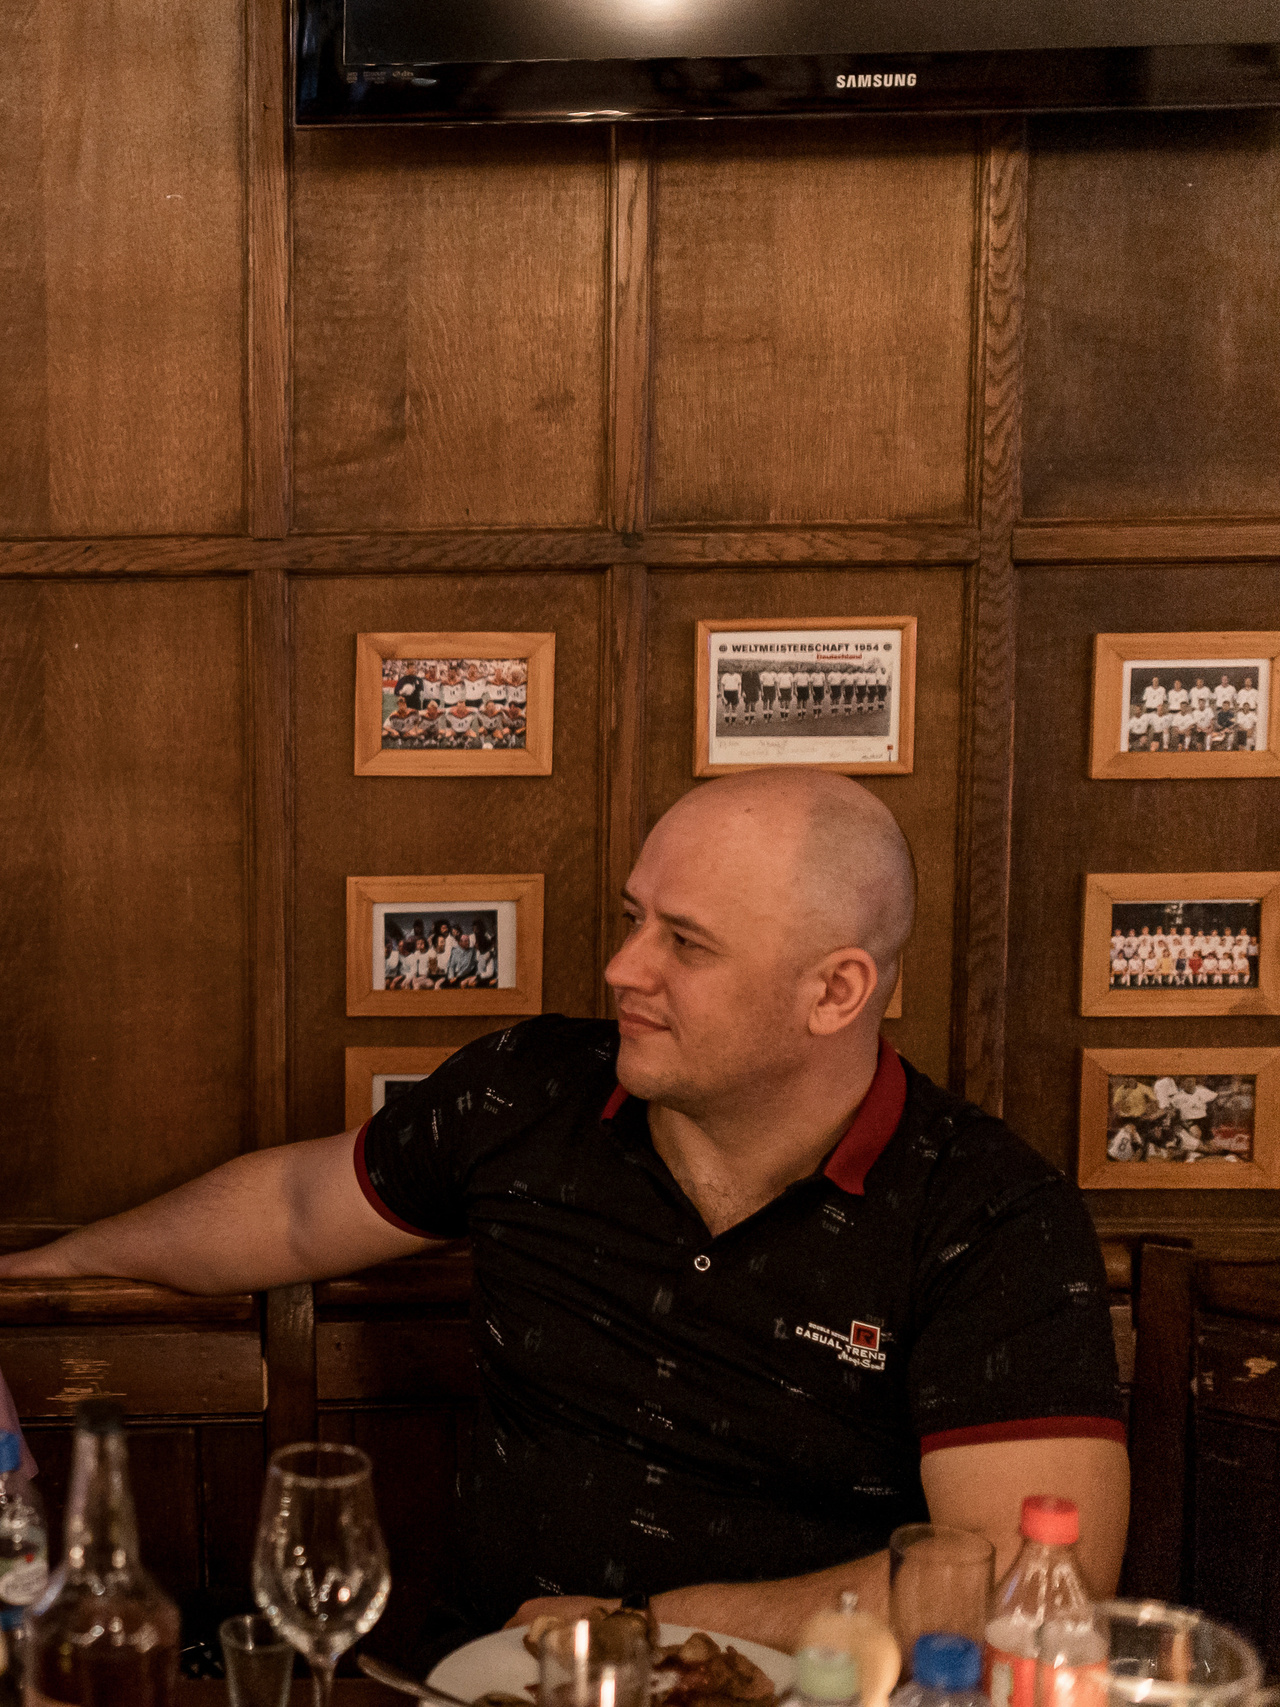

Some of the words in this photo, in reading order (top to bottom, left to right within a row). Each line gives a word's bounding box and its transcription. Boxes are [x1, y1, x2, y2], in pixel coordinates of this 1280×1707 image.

[836, 73, 917, 88] SAMSUNG
[731, 643, 850, 653] WELTMEISTERSCHAFT
[795, 1326, 842, 1350] CASUAL
[845, 1344, 886, 1361] TREND
